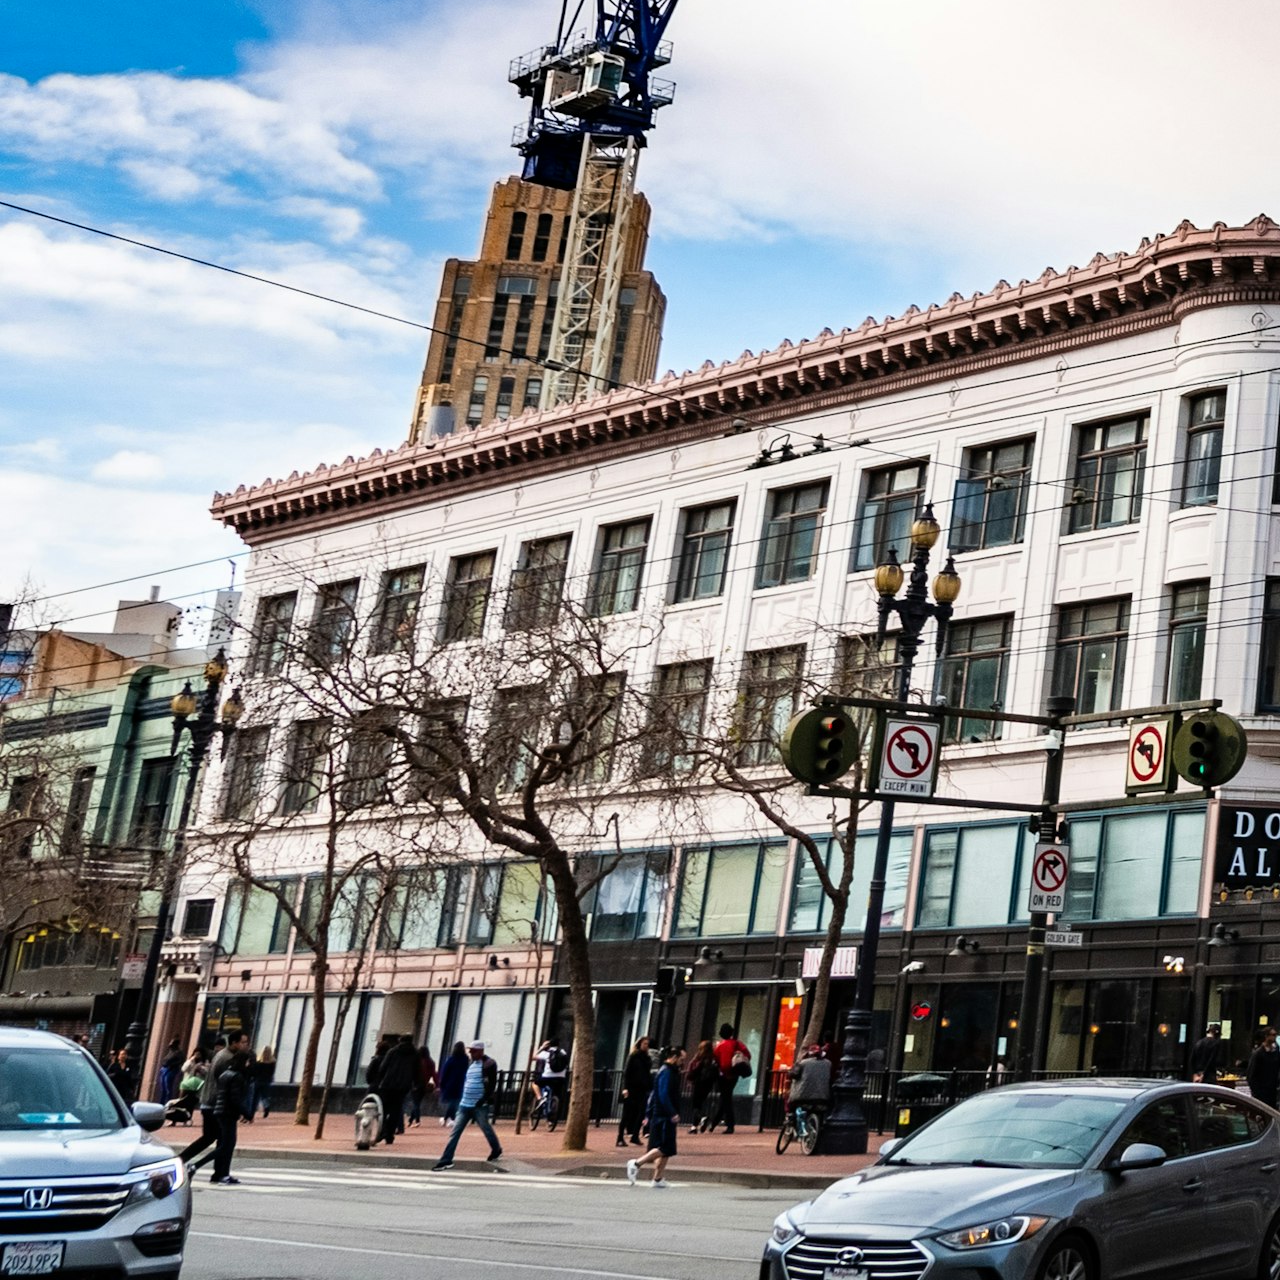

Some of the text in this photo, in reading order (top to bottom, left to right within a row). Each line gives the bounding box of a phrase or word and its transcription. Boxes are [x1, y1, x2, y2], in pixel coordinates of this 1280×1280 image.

[884, 781, 927, 793] EXCEPT MUNI
[1033, 894, 1061, 907] ON RED
[1046, 933, 1081, 944] GOLDEN GATE
[4, 1253, 59, 1271] 20919P2
